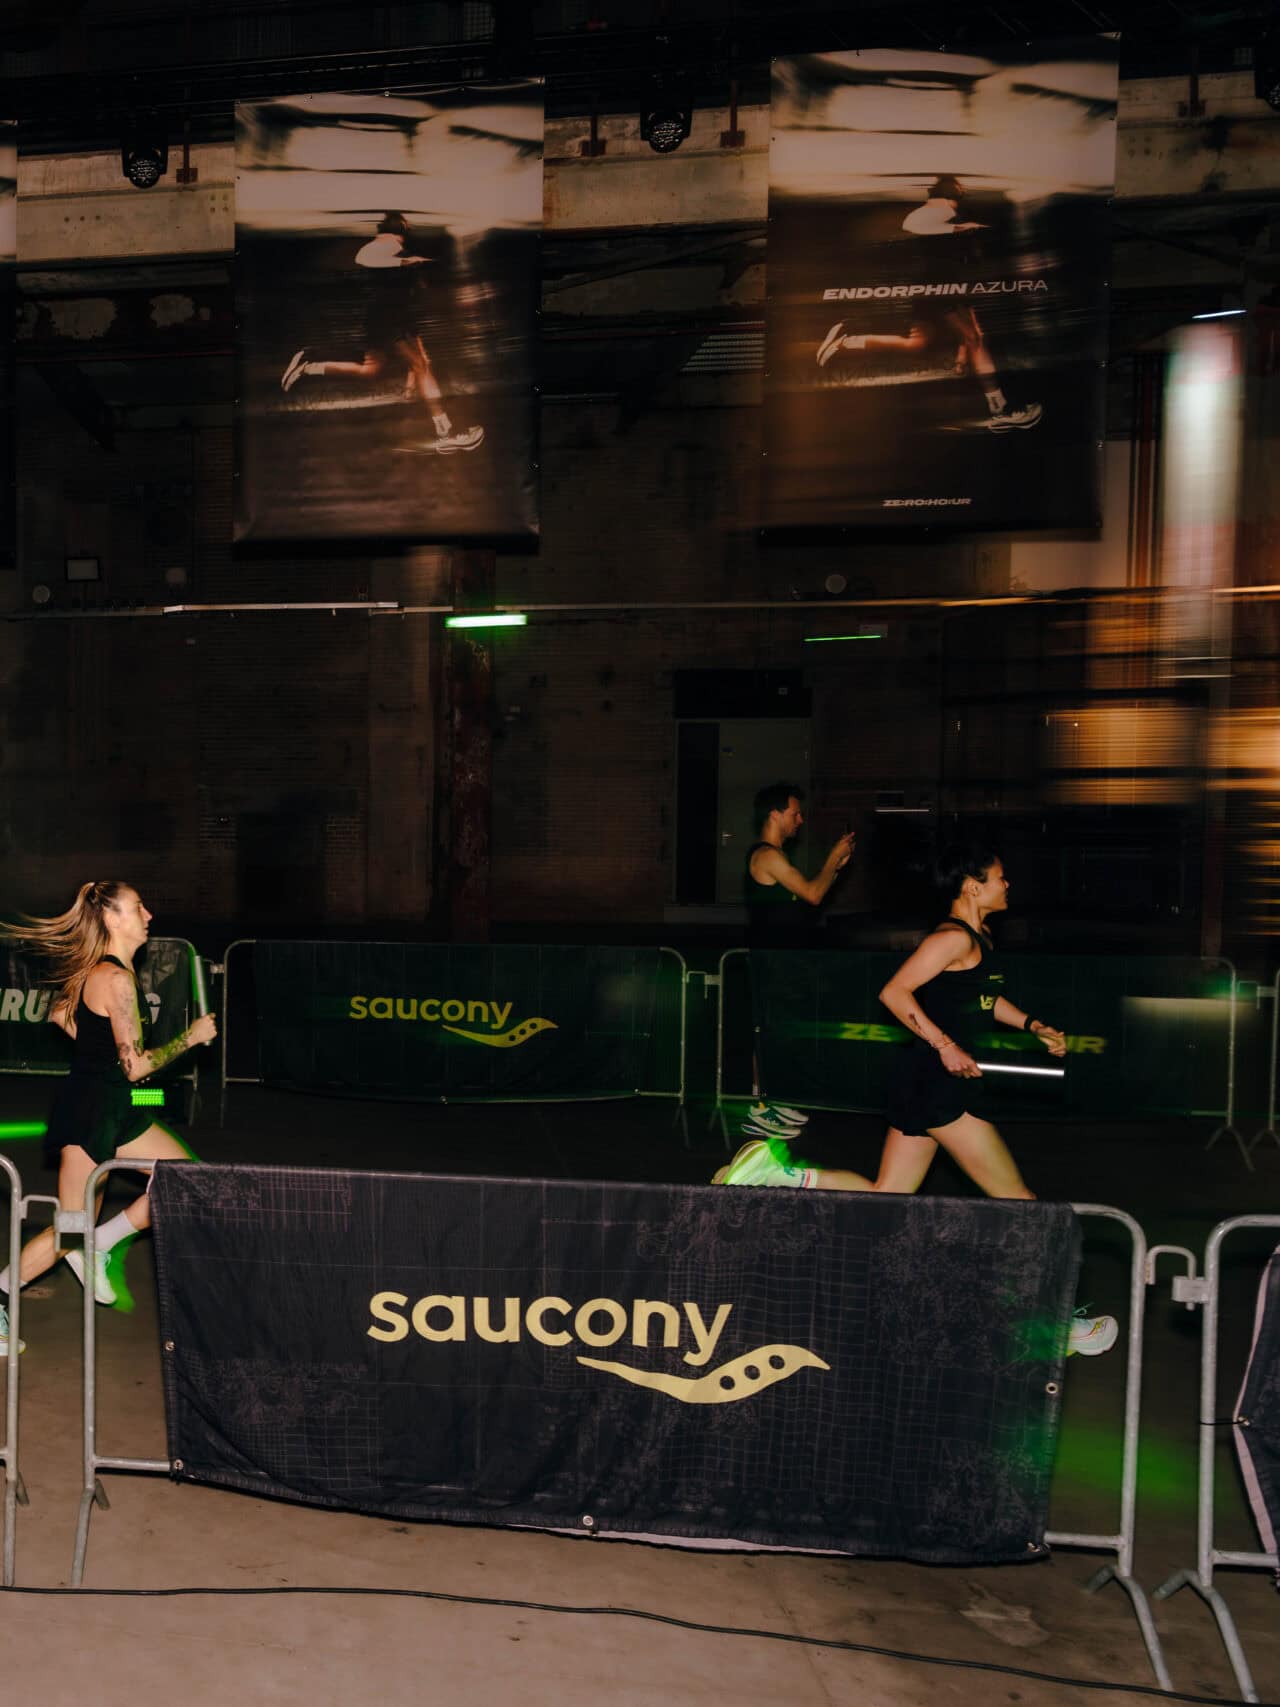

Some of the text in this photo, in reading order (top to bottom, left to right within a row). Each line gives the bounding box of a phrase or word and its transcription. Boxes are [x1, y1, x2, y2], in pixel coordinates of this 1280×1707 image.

[822, 279, 1049, 300] ENDORPHIN AZURA
[349, 996, 513, 1029] saucony
[366, 1291, 733, 1367] saucony
